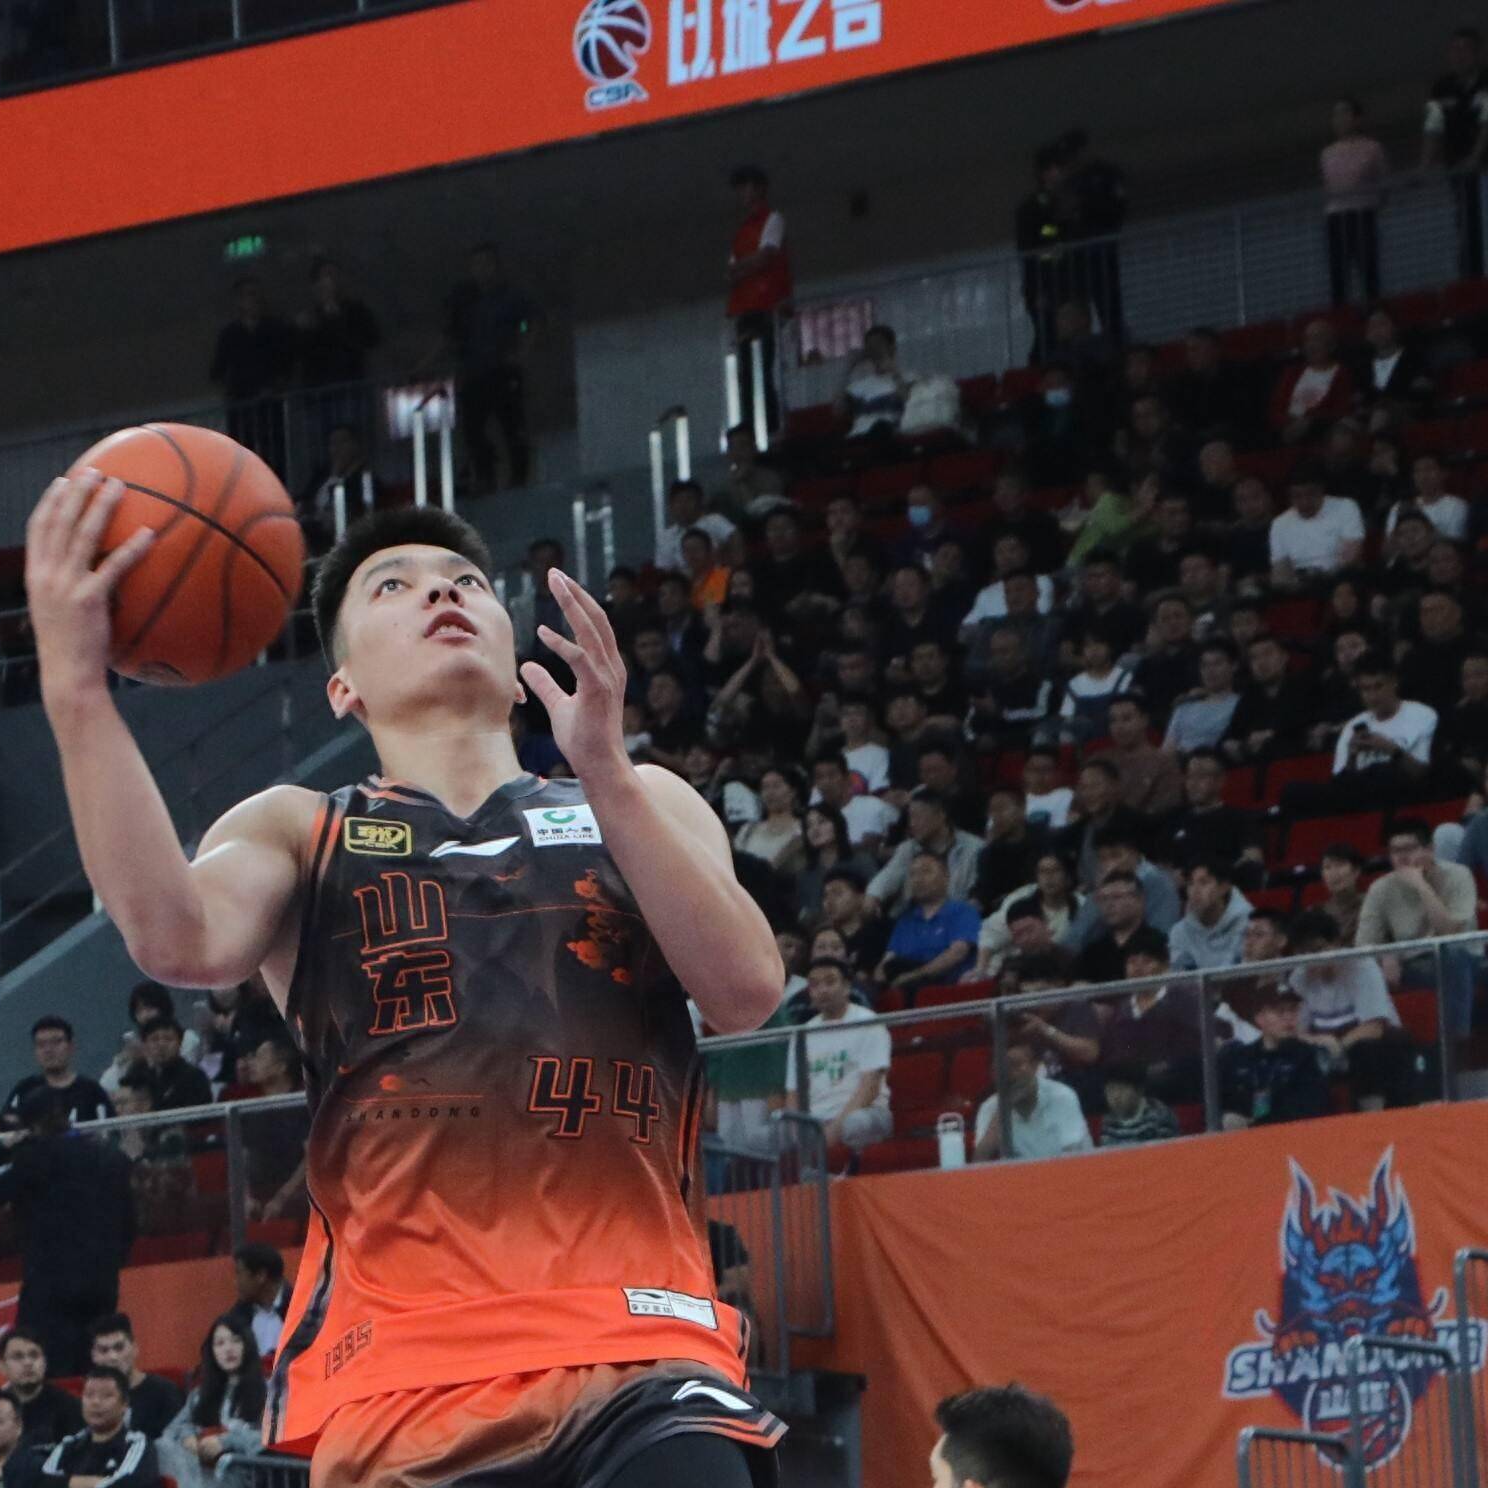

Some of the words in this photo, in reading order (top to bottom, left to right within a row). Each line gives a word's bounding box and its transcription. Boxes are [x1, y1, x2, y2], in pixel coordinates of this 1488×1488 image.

[353, 872, 457, 1036] 山东
[528, 1055, 661, 1144] 44
[323, 1320, 373, 1381] 1995
